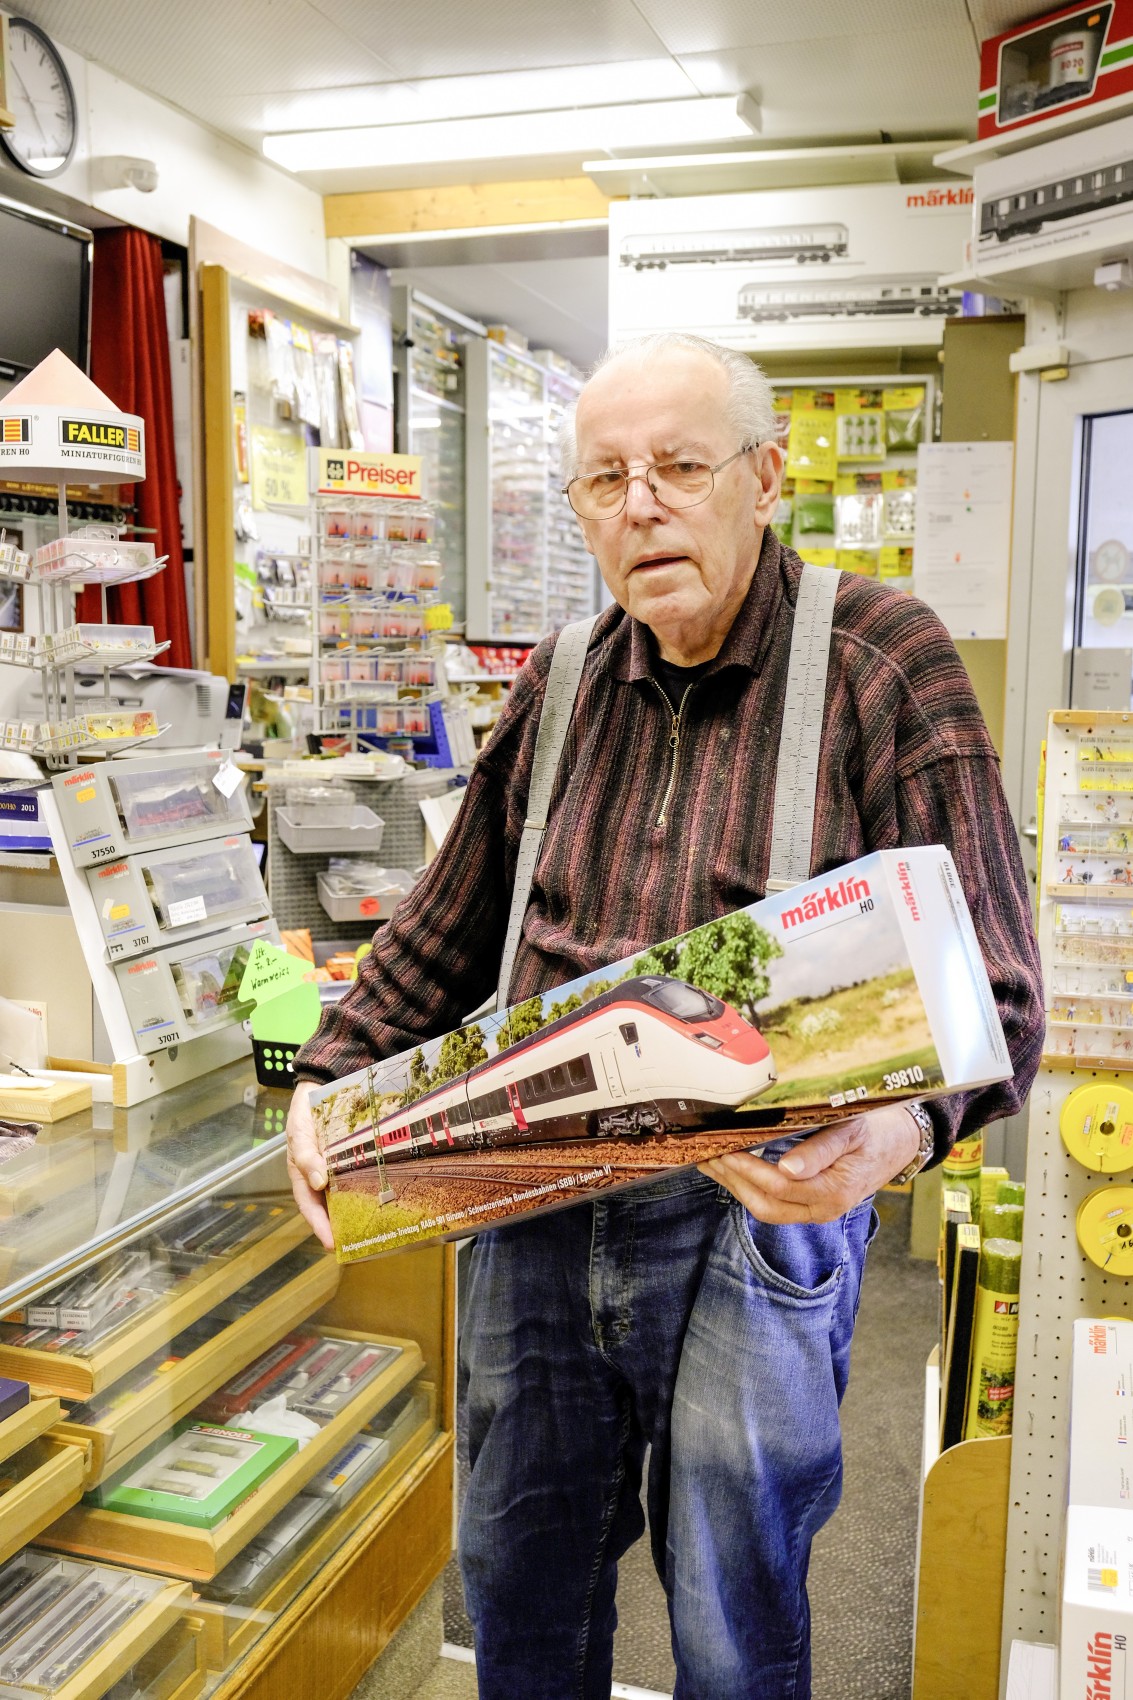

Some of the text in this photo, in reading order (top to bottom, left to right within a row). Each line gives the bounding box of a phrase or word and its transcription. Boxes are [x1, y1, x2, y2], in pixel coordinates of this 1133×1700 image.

[68, 423, 125, 447] FALLER
[61, 449, 137, 464] MINIATURFIGUREN
[347, 461, 416, 485] Preiser
[64, 771, 95, 787] märklin
[21, 804, 35, 812] 2013
[91, 845, 116, 859] 37550
[896, 862, 921, 921] märklin
[781, 876, 872, 930] märklin
[859, 898, 876, 914] H0
[133, 935, 150, 948] 3767
[158, 1031, 181, 1045] 37071
[882, 1064, 925, 1092] 39810
[341, 1224, 420, 1253] Hochgeschwindigkeits-Triebzug
[420, 1219, 436, 1230] RABe
[467, 1196, 513, 1215] Schweizerische
[512, 1183, 557, 1201] Bundesbahnen
[557, 1176, 576, 1190] (SBB)
[579, 1168, 604, 1183] Epoche
[1088, 1324, 1107, 1354] märklin
[203, 1427, 253, 1440] ARNOLD
[1114, 1634, 1127, 1650] H0
[1086, 1631, 1112, 1700] ärklin
